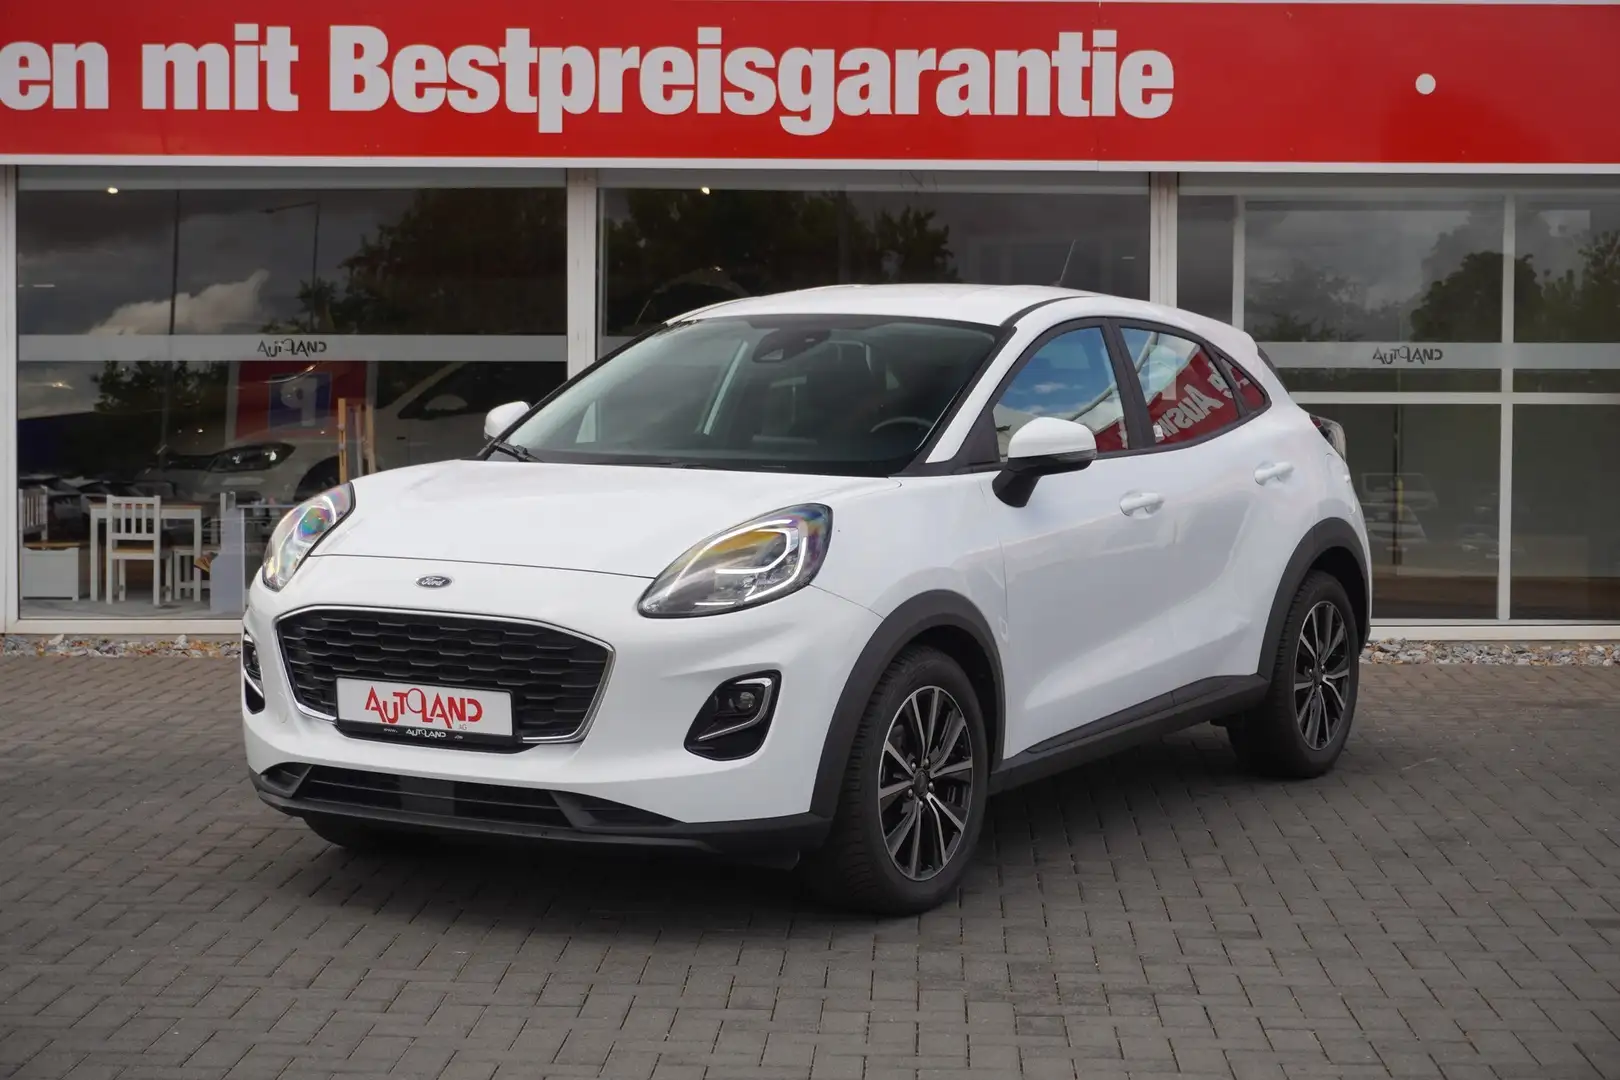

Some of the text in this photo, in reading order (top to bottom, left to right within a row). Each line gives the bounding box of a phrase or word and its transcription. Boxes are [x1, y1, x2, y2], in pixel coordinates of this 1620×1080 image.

[0, 24, 1175, 136] en mit Bestpreisgarantie
